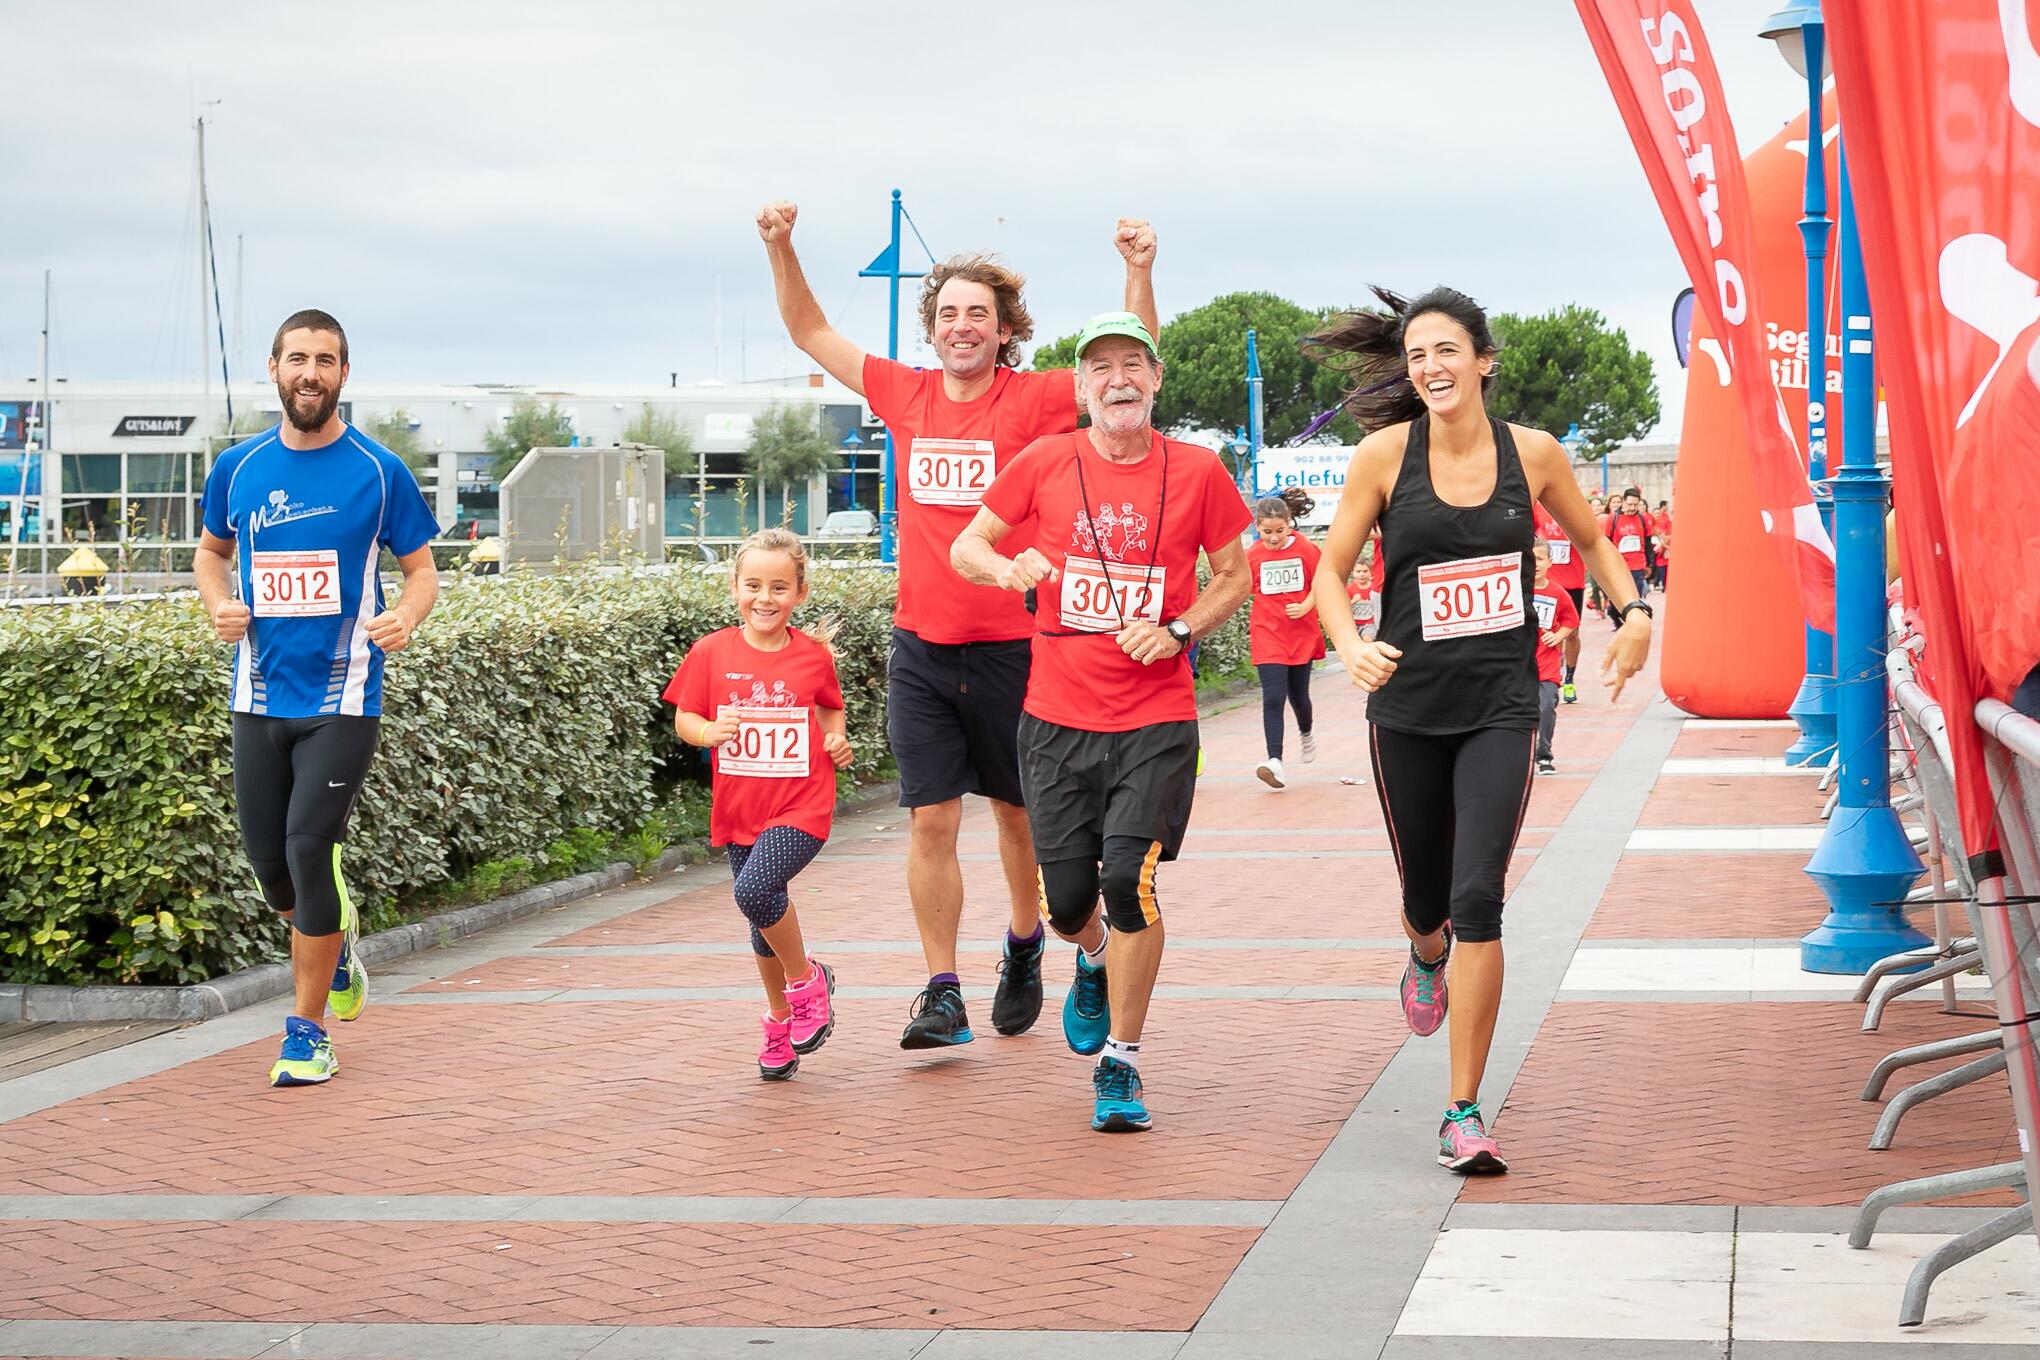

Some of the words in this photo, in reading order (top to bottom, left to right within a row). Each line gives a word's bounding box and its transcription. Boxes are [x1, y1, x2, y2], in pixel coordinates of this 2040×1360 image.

[918, 457, 985, 488] 3012
[1295, 455, 1314, 463] 902
[1319, 455, 1332, 463] 88
[1274, 469, 1344, 487] telefu
[262, 570, 330, 602] 3012
[1266, 568, 1299, 586] 2004
[1072, 578, 1152, 618] 3012
[1432, 576, 1514, 622] 3012
[727, 727, 799, 759] 3012
